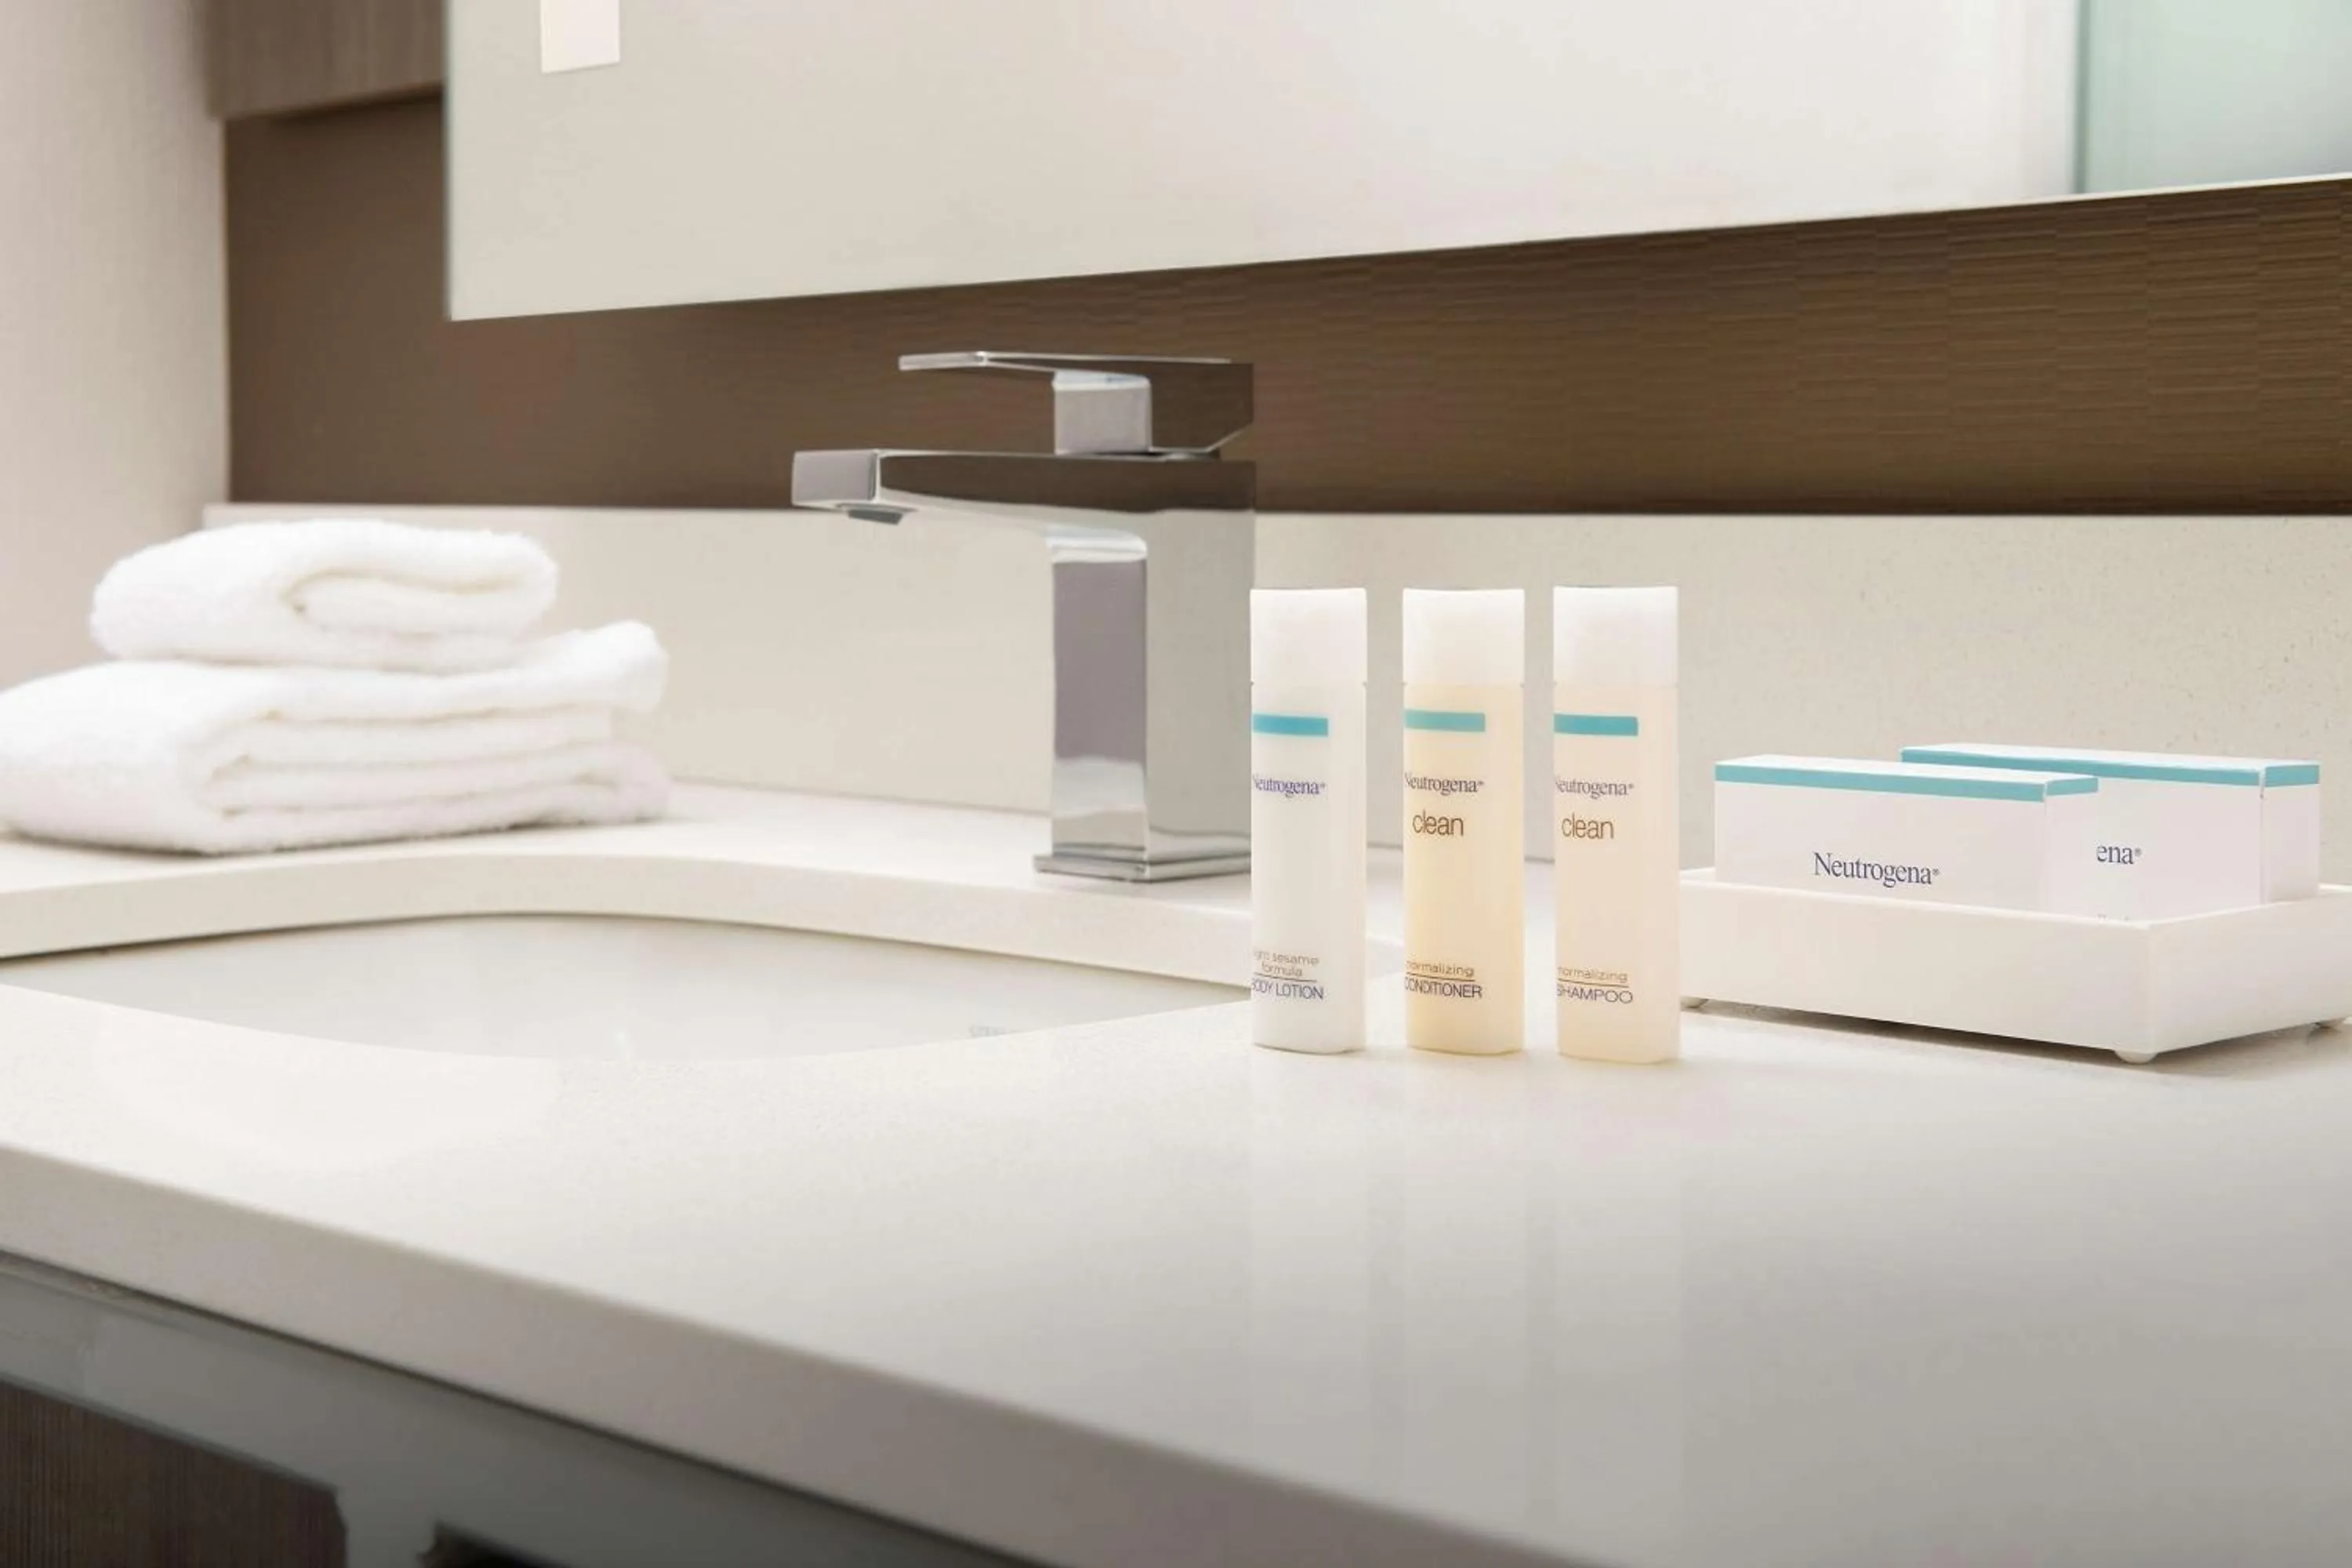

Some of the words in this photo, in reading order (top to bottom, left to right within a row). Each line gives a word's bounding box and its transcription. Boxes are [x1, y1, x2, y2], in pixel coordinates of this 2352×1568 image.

[1412, 808, 1464, 836] clean
[1561, 813, 1614, 839] clean
[1272, 953, 1319, 965] sesame
[1261, 961, 1302, 977] formula
[1406, 960, 1475, 978] normalizing
[1276, 983, 1324, 1000] LOTION
[1405, 977, 1483, 998] CONDITIONER
[1556, 984, 1633, 1004] SHAMPOO
